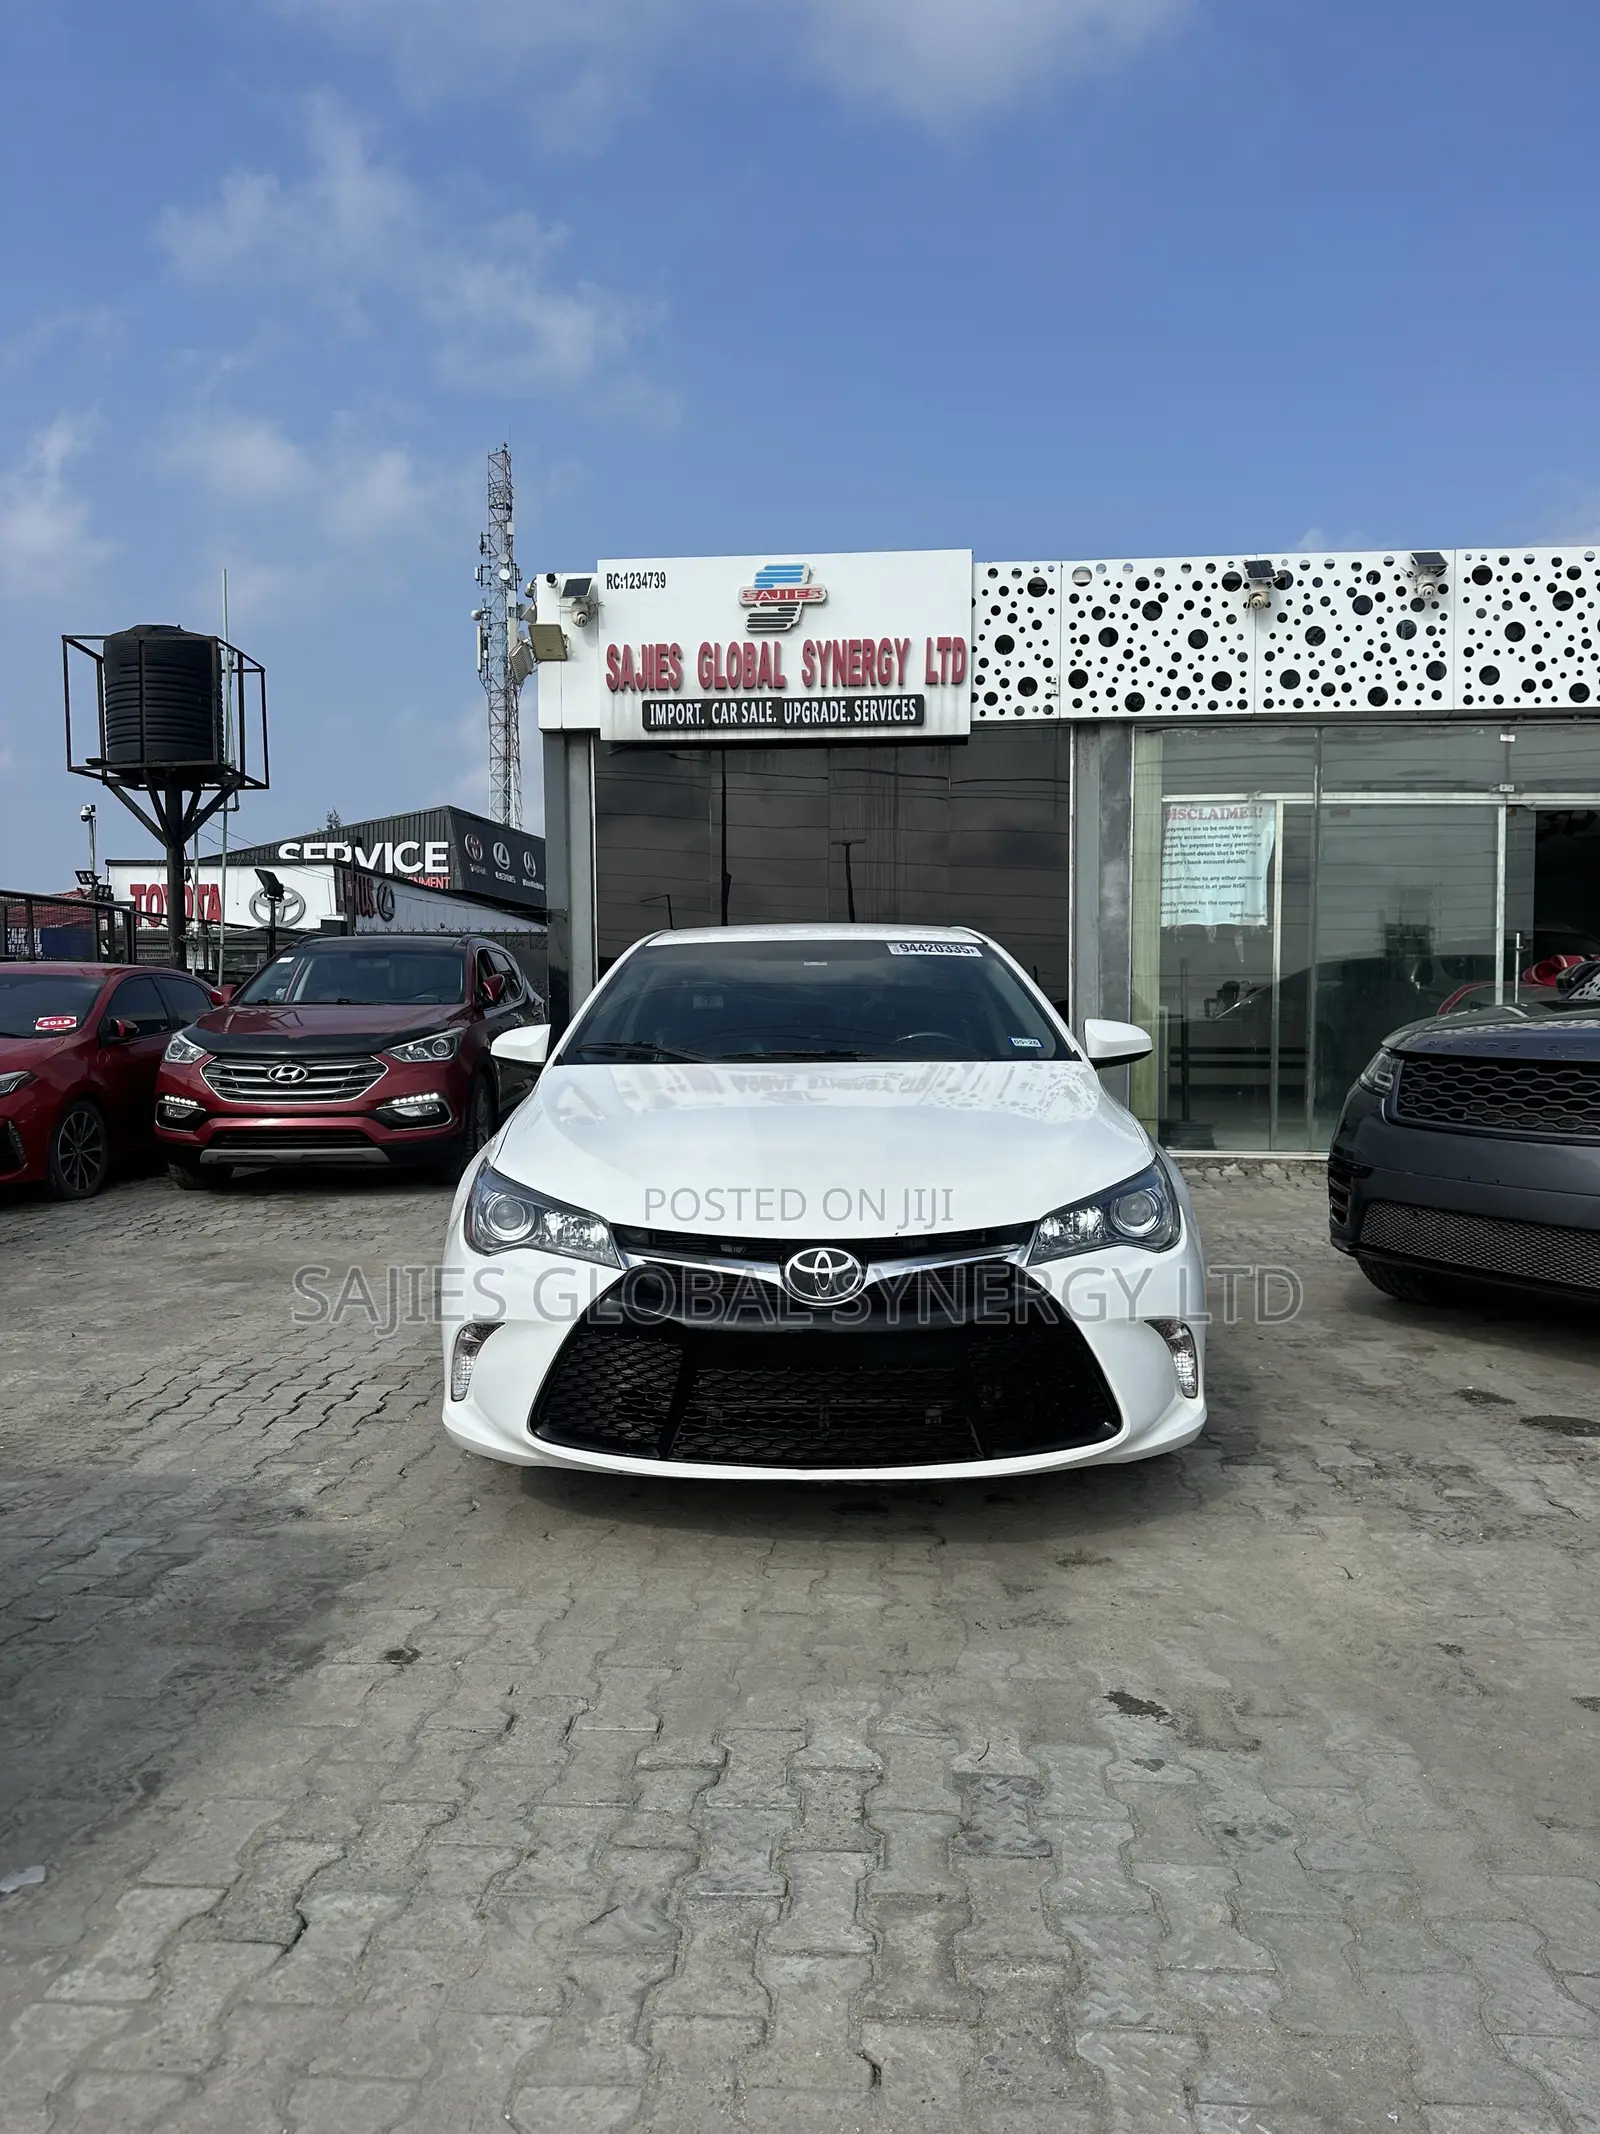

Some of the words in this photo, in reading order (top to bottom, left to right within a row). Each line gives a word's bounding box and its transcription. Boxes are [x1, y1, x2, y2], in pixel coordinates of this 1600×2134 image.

[606, 571, 667, 590] RC:1234739
[742, 587, 824, 602] SAJIES
[606, 643, 683, 691] SAJIES
[697, 641, 788, 690] GLOBAL
[801, 637, 912, 688] SYNERGY
[925, 637, 968, 686] LTD
[650, 703, 705, 725] IMPORT.
[712, 702, 739, 723] CAR
[741, 701, 778, 723] SALE.
[783, 700, 851, 723] UPGRADE.
[854, 698, 916, 722] SERVICES
